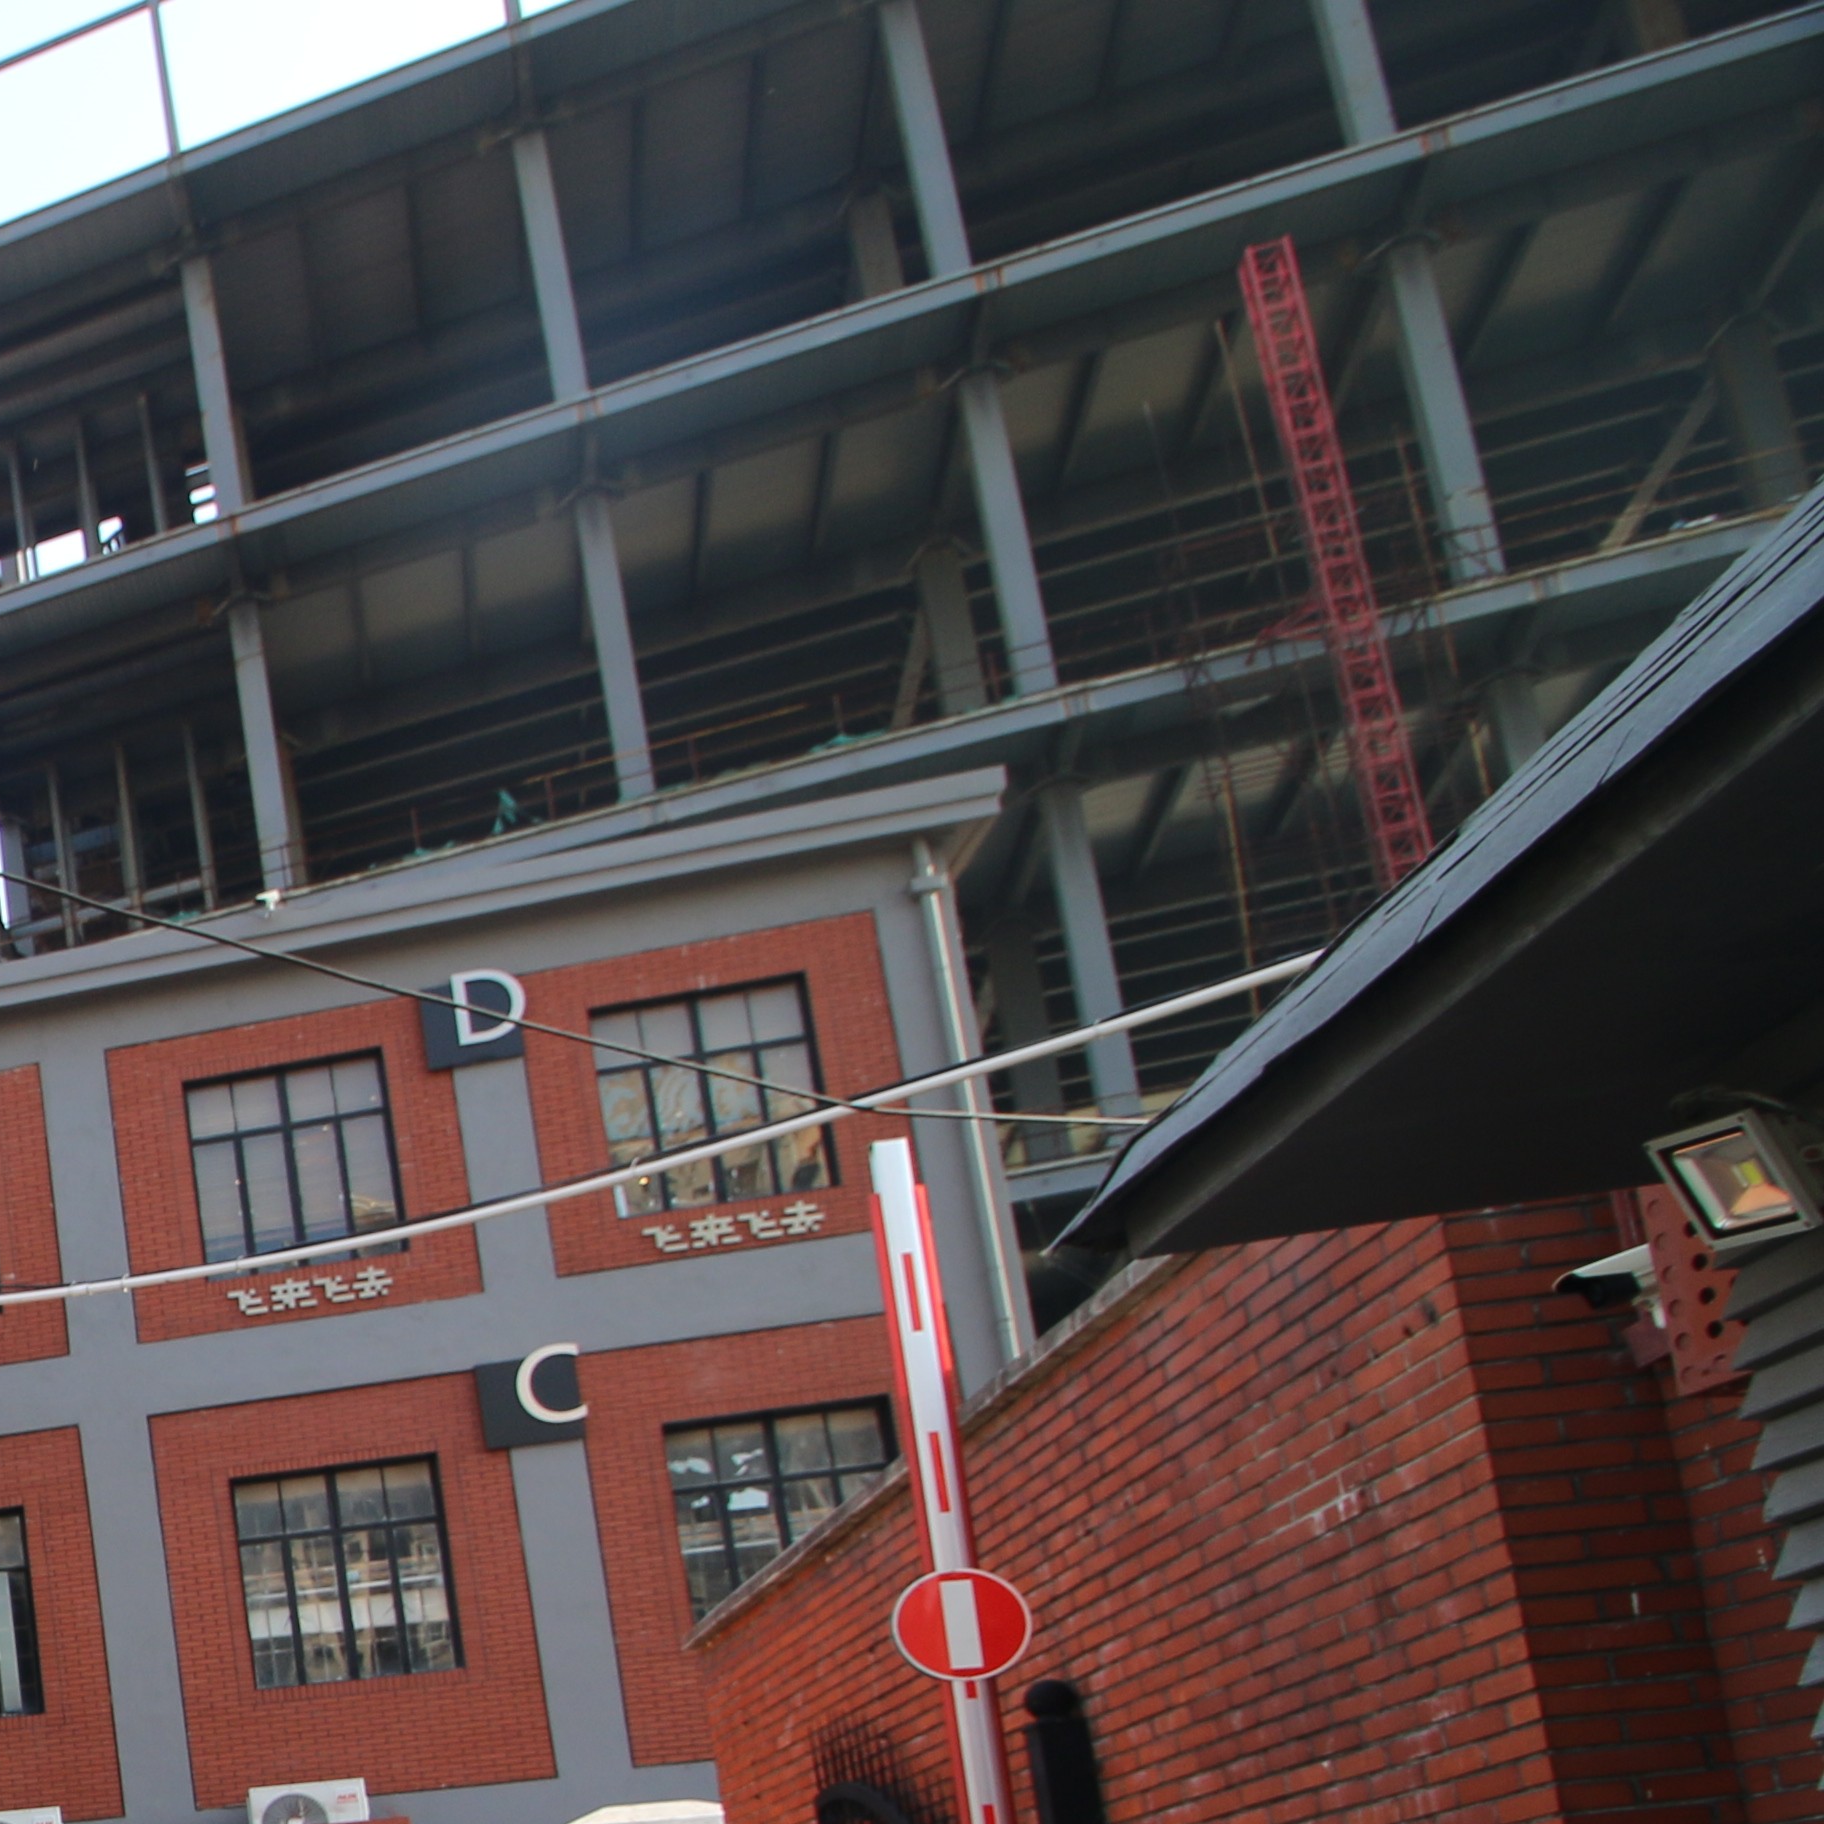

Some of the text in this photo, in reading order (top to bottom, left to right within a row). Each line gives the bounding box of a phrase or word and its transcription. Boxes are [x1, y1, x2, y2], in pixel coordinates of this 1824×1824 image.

[451, 969, 526, 1046] D
[641, 1200, 826, 1253] 飞来飞去
[227, 1265, 394, 1316] 飞来飞去
[515, 1342, 588, 1424] C
